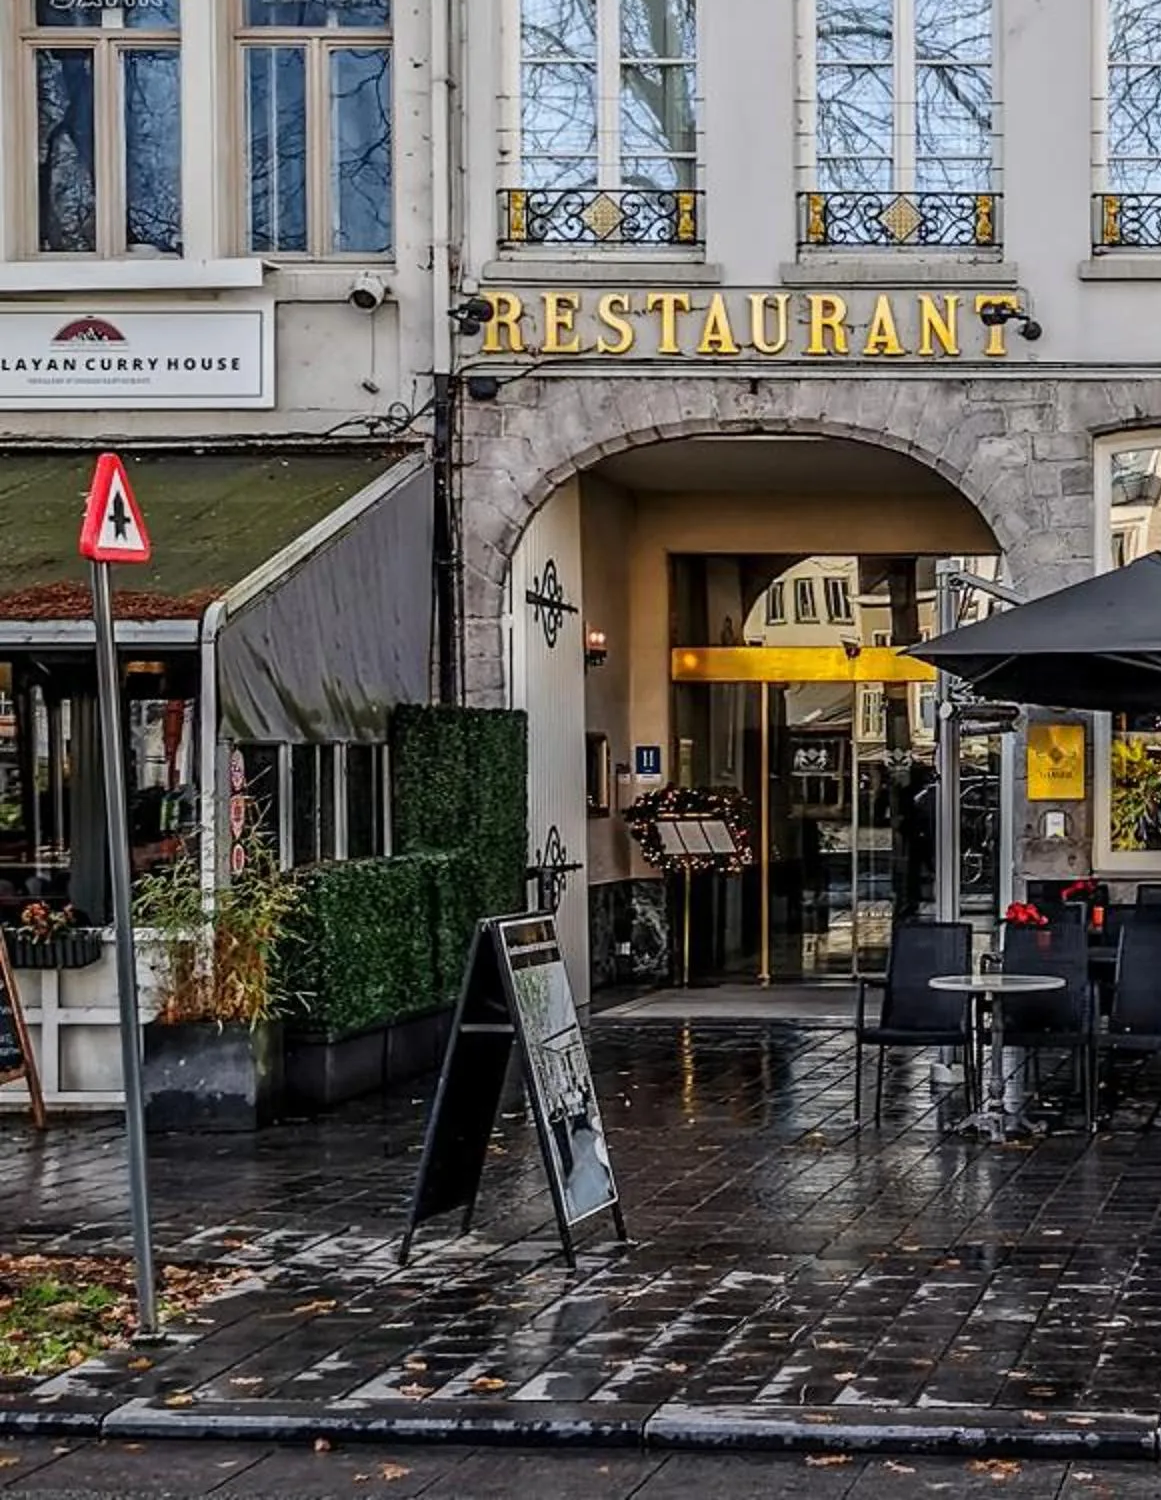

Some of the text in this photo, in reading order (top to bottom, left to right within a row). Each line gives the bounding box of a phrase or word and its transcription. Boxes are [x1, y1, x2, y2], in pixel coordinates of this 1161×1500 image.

[481, 291, 1020, 356] RESTAURANT
[85, 358, 159, 371] CURRY
[167, 358, 241, 371] HOUSE
